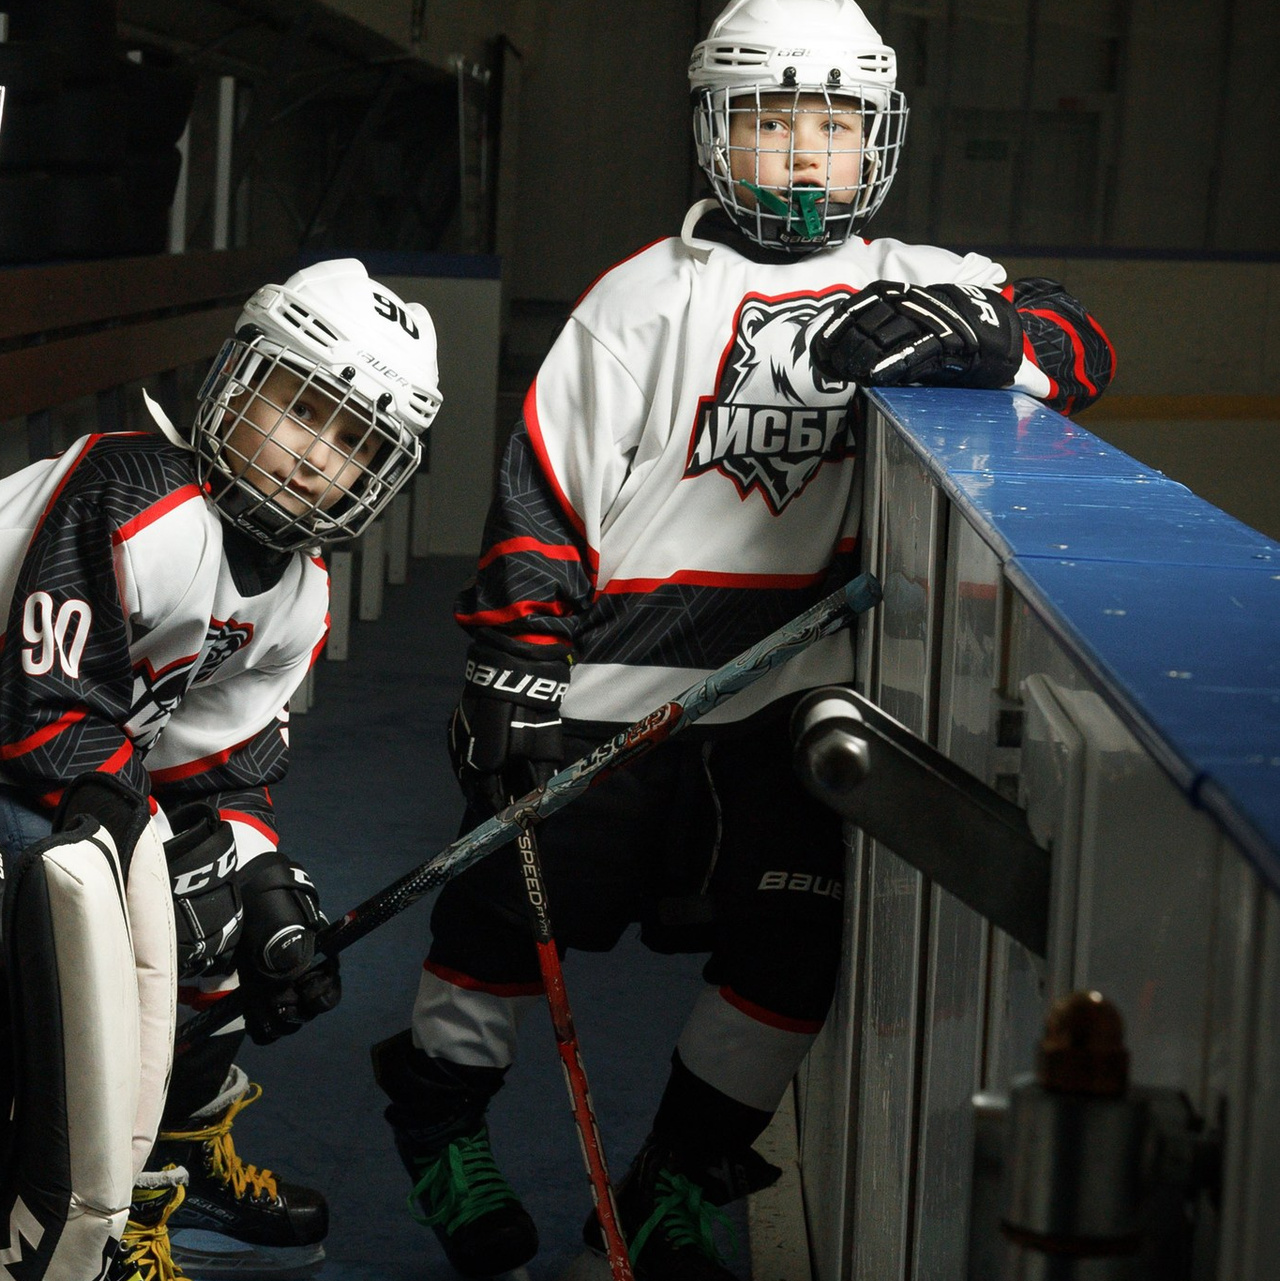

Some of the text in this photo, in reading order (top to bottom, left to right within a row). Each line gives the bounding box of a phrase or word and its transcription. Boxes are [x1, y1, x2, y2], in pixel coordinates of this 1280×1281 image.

[372, 291, 420, 340] 90
[20, 590, 94, 680] 90
[465, 659, 570, 703] BAUER
[756, 870, 845, 901] BAUE
